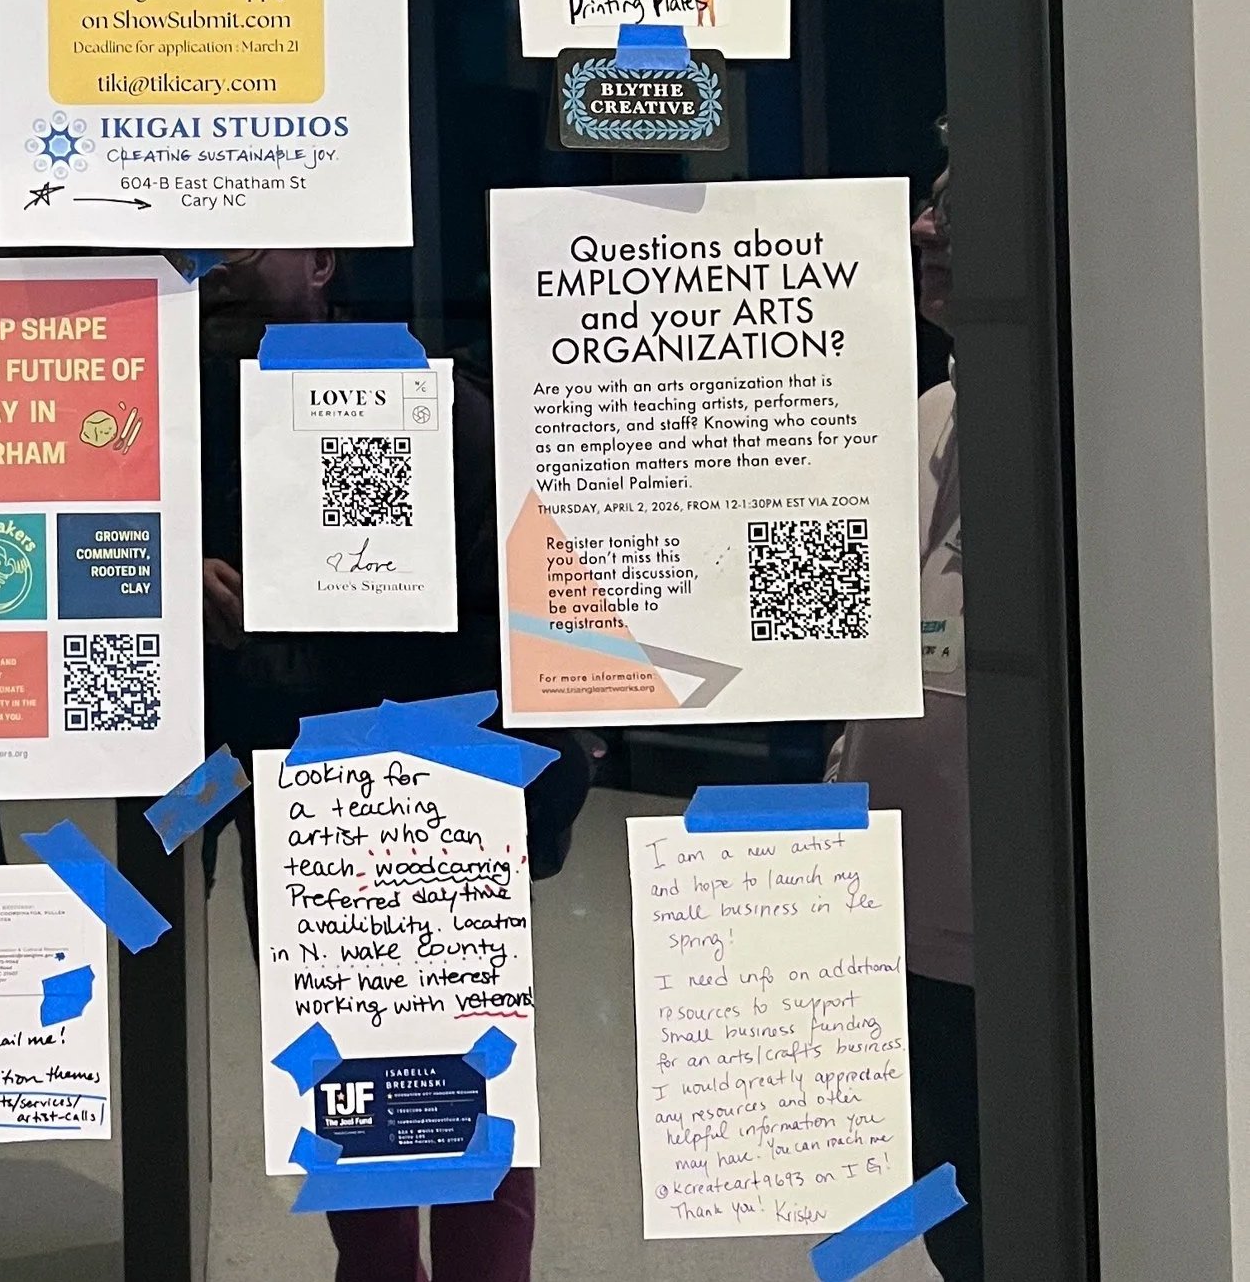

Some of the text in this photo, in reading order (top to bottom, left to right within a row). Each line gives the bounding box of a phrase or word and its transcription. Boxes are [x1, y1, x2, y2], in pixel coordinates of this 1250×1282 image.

[82, 10, 290, 28] on ShowSubmit.com
[74, 41, 132, 53] Deadline
[136, 40, 154, 53] for
[158, 40, 232, 56] application
[242, 39, 283, 52] March
[98, 73, 276, 96] tiki@tikicary.com
[601, 83, 683, 97] BLYTHE
[591, 100, 695, 114] CREATIVE
[101, 117, 348, 138] IKIGAI STUDIOS
[121, 176, 306, 189] 604-B East Chatham St
[571, 228, 823, 262] Questions about
[538, 262, 858, 296] EMPLOYMENT LAW
[582, 297, 813, 337] and your ARTS
[22, 316, 106, 340] SHAPE
[553, 330, 844, 364] ORGANIZATION?
[7, 359, 105, 381] FUTURE
[112, 357, 146, 381] OF
[311, 390, 385, 405] LOVE'S
[31, 400, 55, 422] IN
[537, 475, 692, 491] With Daniel Palmieri.
[96, 530, 149, 541] GROWING
[77, 547, 150, 560] COMMUNITY,
[90, 566, 151, 577] ROOTED IN
[120, 583, 151, 593] CLAY
[318, 581, 424, 594] Love's Signature
[550, 617, 628, 633] registrants.
[279, 761, 430, 798] Looking for
[290, 797, 446, 829] a teaching
[646, 831, 845, 869] I am a new artist
[320, 1082, 374, 1116] TJF
[325, 1118, 340, 1127] The
[355, 1117, 373, 1125] Fund
[671, 1202, 722, 1219] Thank
[732, 1195, 764, 1219] you!
